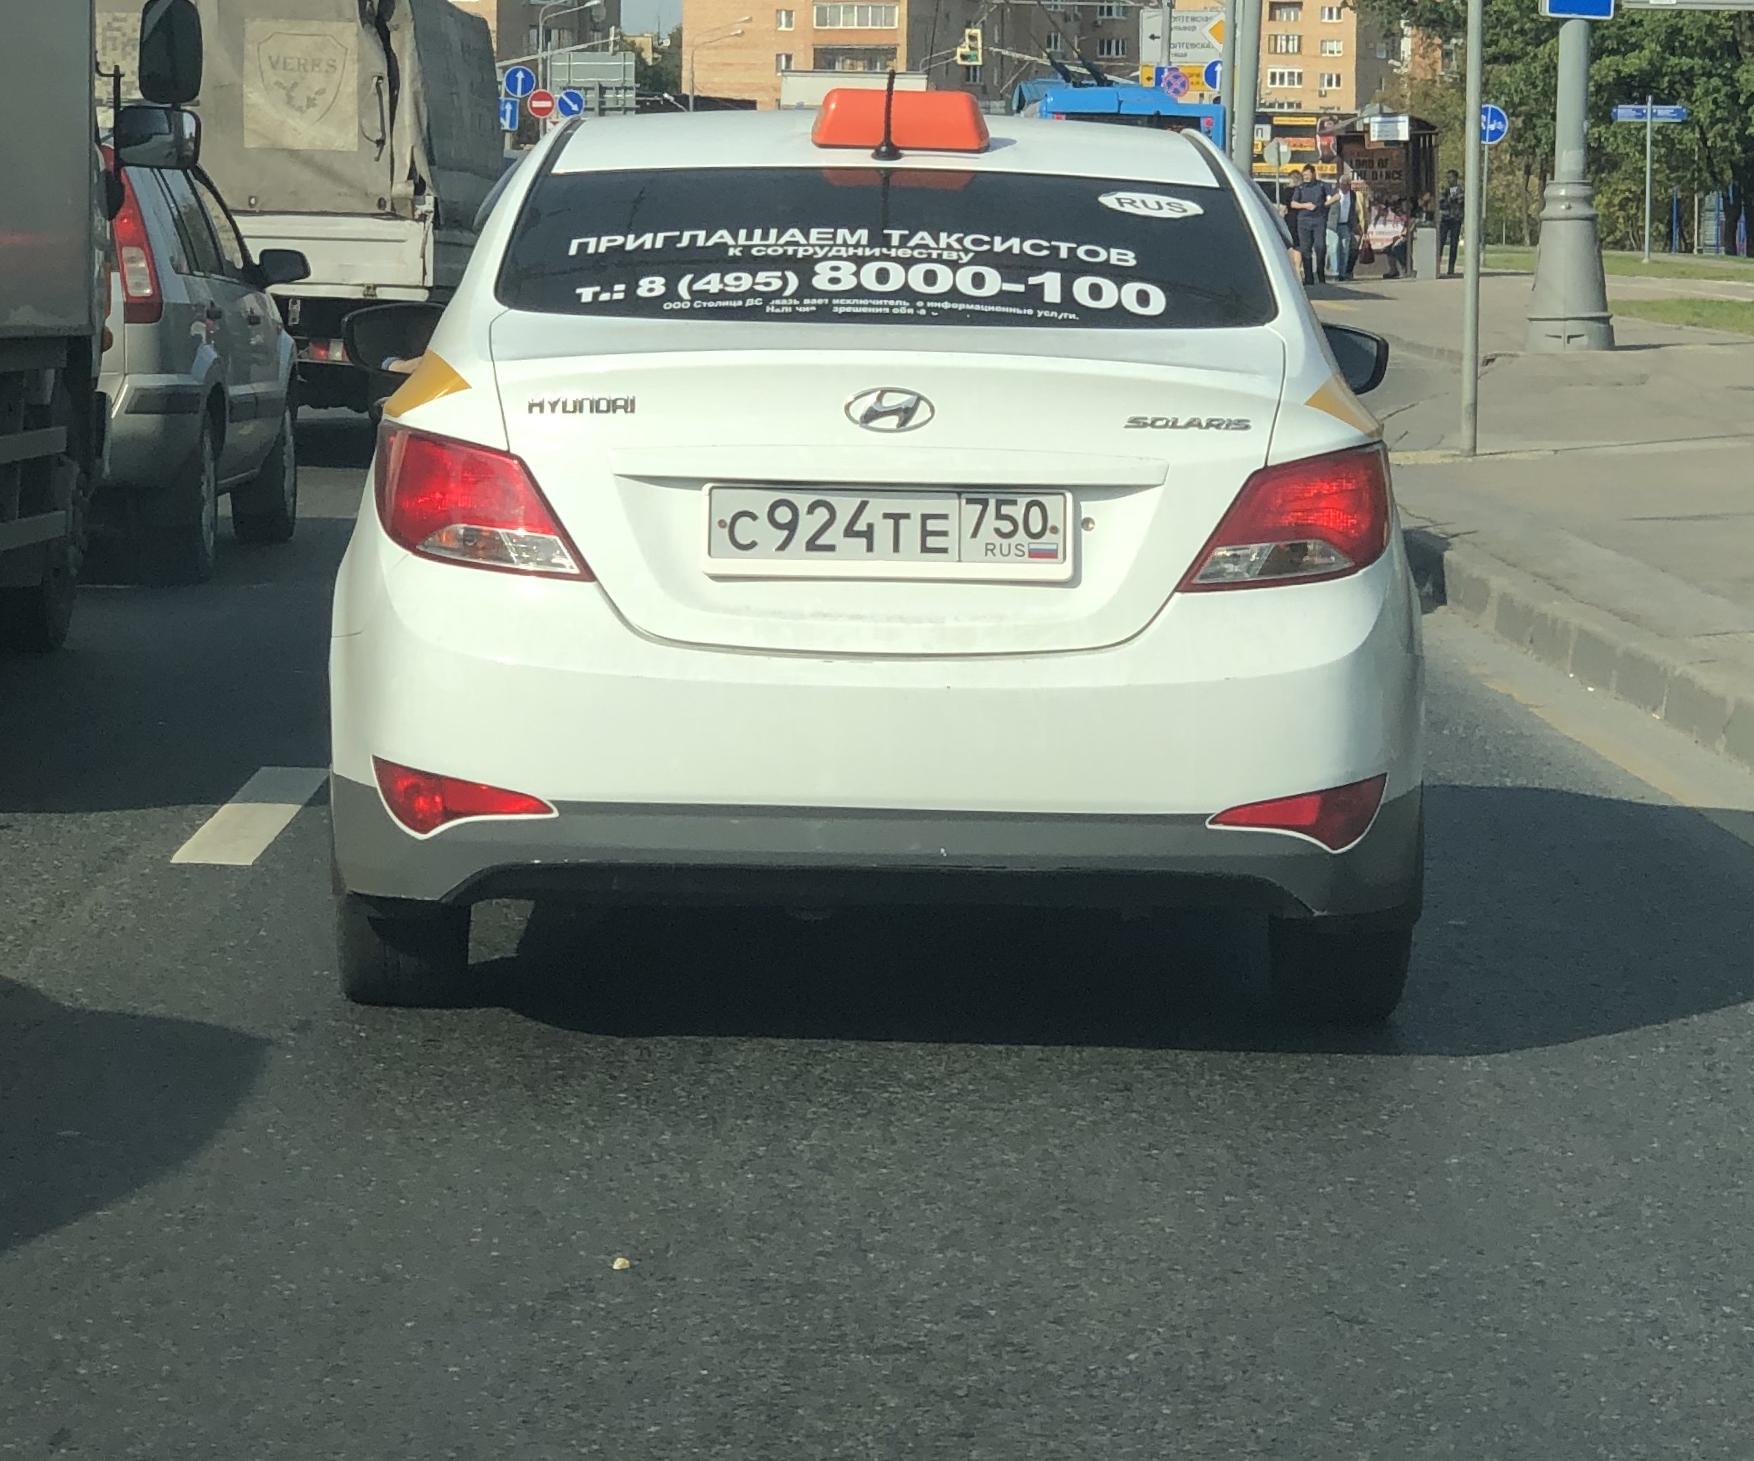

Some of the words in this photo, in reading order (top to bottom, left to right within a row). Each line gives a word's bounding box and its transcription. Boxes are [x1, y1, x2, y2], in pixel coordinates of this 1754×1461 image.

[267, 55, 337, 73] VERES
[1115, 196, 1189, 214] RUS
[568, 228, 868, 256] ПРИГЛАШАЕМ
[883, 229, 1138, 267] ТАКСИСТОВ
[751, 246, 976, 263] сотрудничеству
[636, 276, 667, 298] 8
[677, 270, 799, 300] (495)
[812, 260, 1167, 316] 8000-100
[662, 300, 690, 310] ООО
[693, 299, 743, 309] Столица
[527, 395, 636, 414] HYUNDAI
[1123, 416, 1252, 431] SOLARIS
[964, 497, 1049, 540] 750
[984, 542, 1026, 558] RUS
